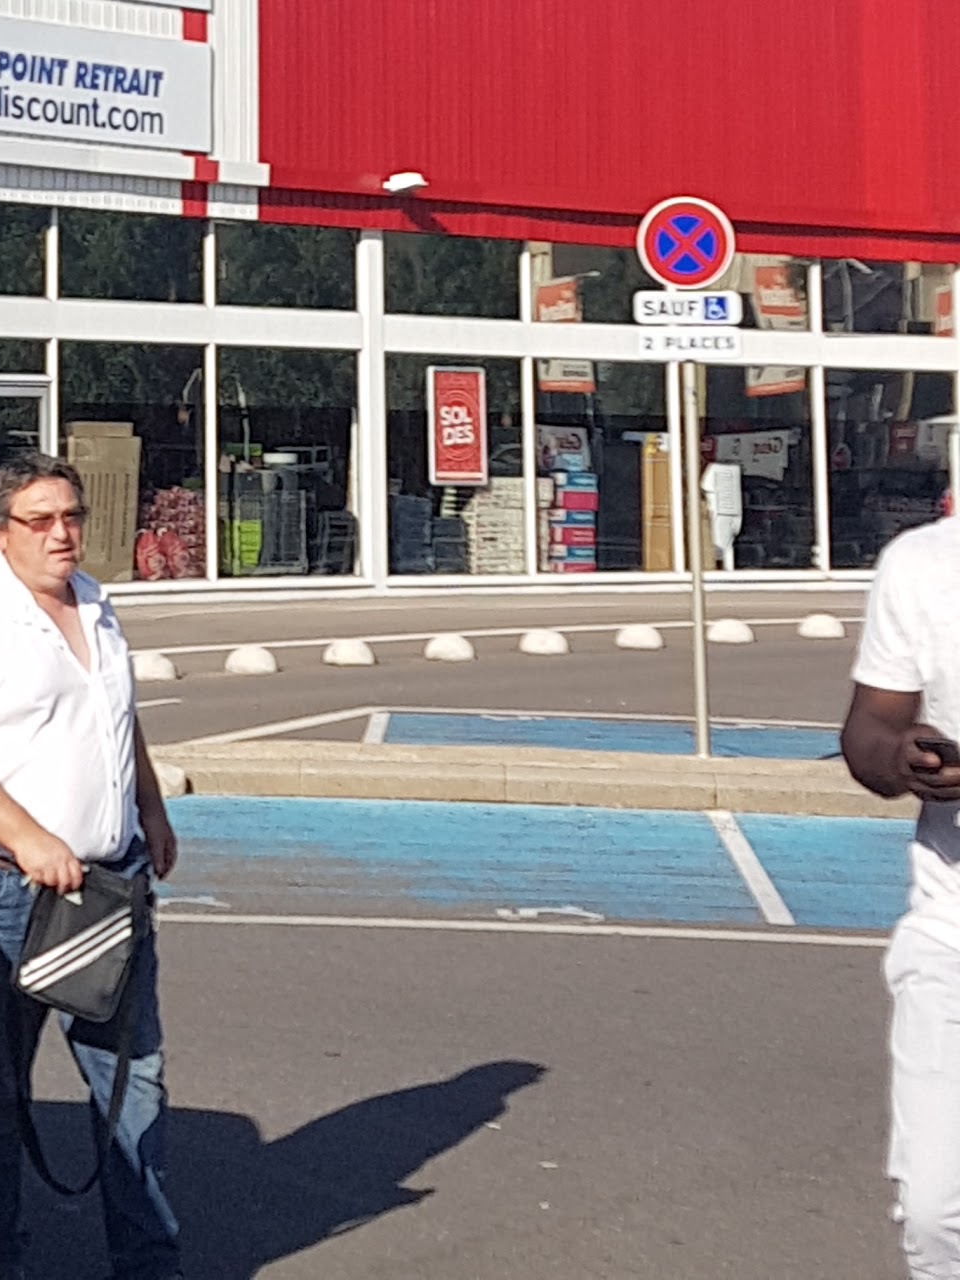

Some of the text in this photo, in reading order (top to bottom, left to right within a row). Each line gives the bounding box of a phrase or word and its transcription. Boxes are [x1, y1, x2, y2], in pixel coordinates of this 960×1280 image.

[75, 61, 164, 98] RETRAIT
[643, 300, 699, 317] SAUF
[644, 336, 735, 350] 2 PLACES
[440, 406, 474, 426] SOL
[443, 425, 475, 446] DES
